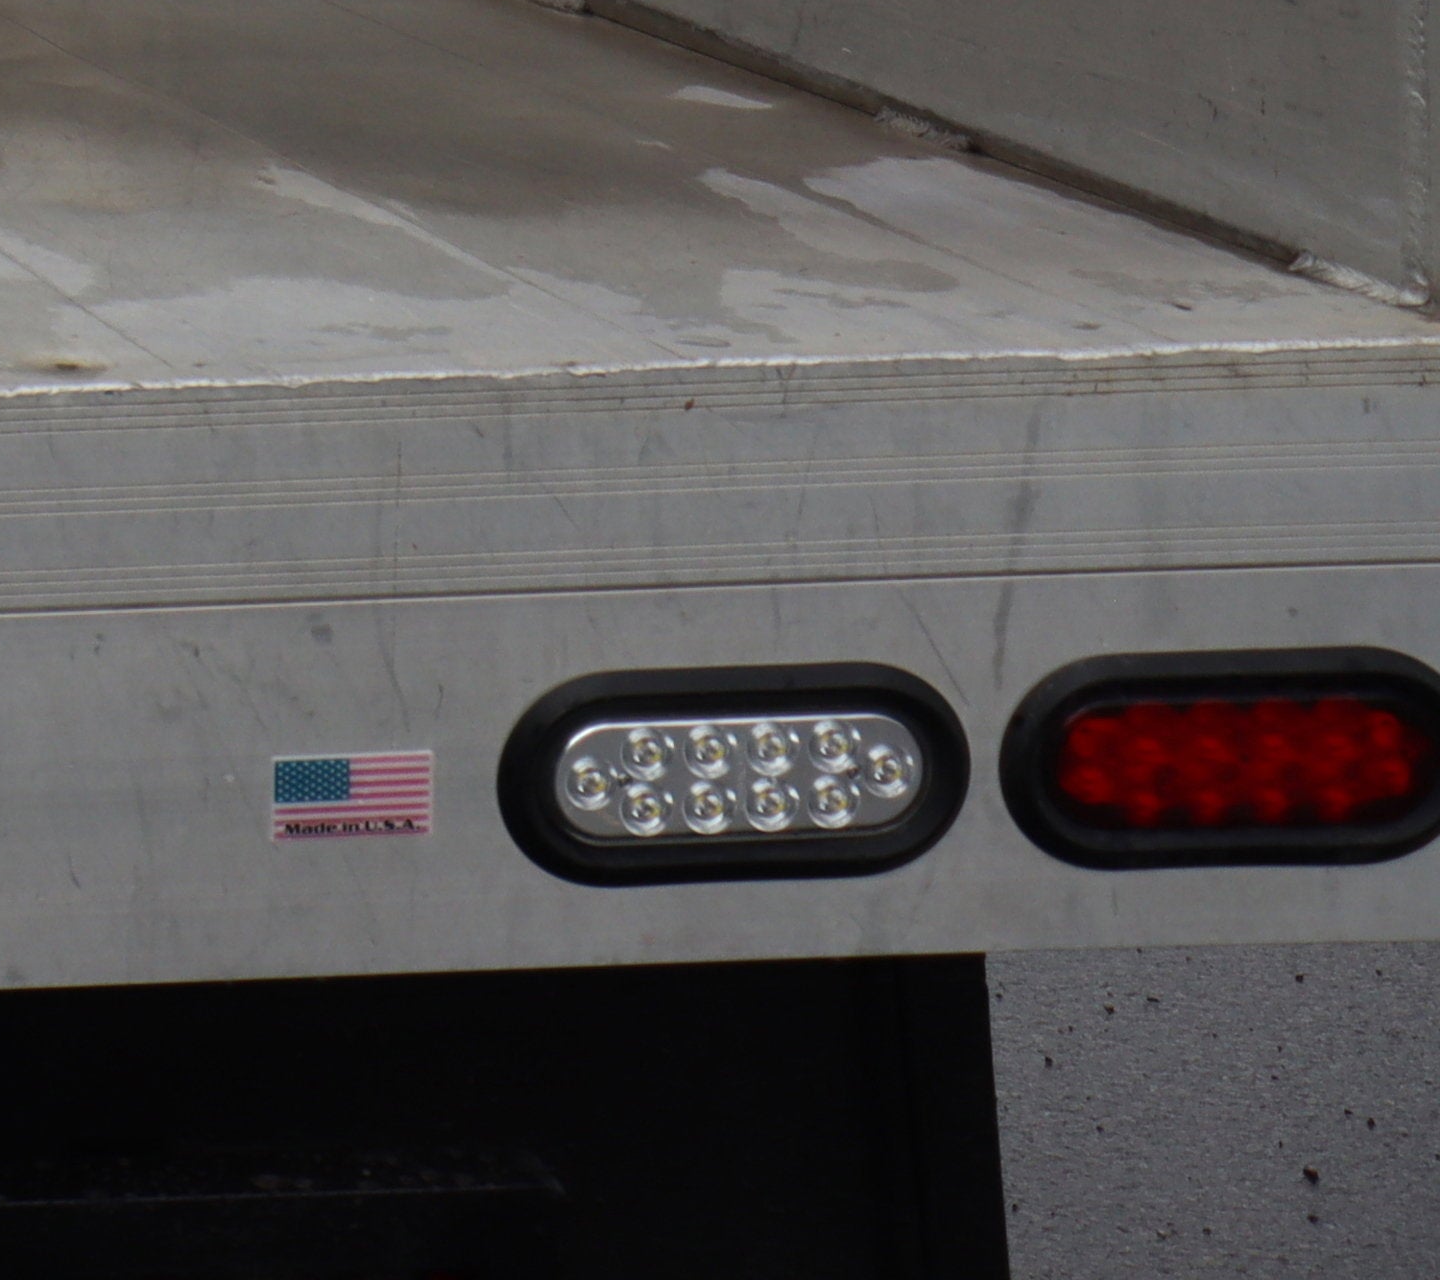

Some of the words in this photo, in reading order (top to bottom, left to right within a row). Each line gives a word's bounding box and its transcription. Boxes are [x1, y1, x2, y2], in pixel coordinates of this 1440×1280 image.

[284, 823, 337, 835] Made
[343, 822, 359, 832] in
[365, 818, 421, 831] U.S.A.
